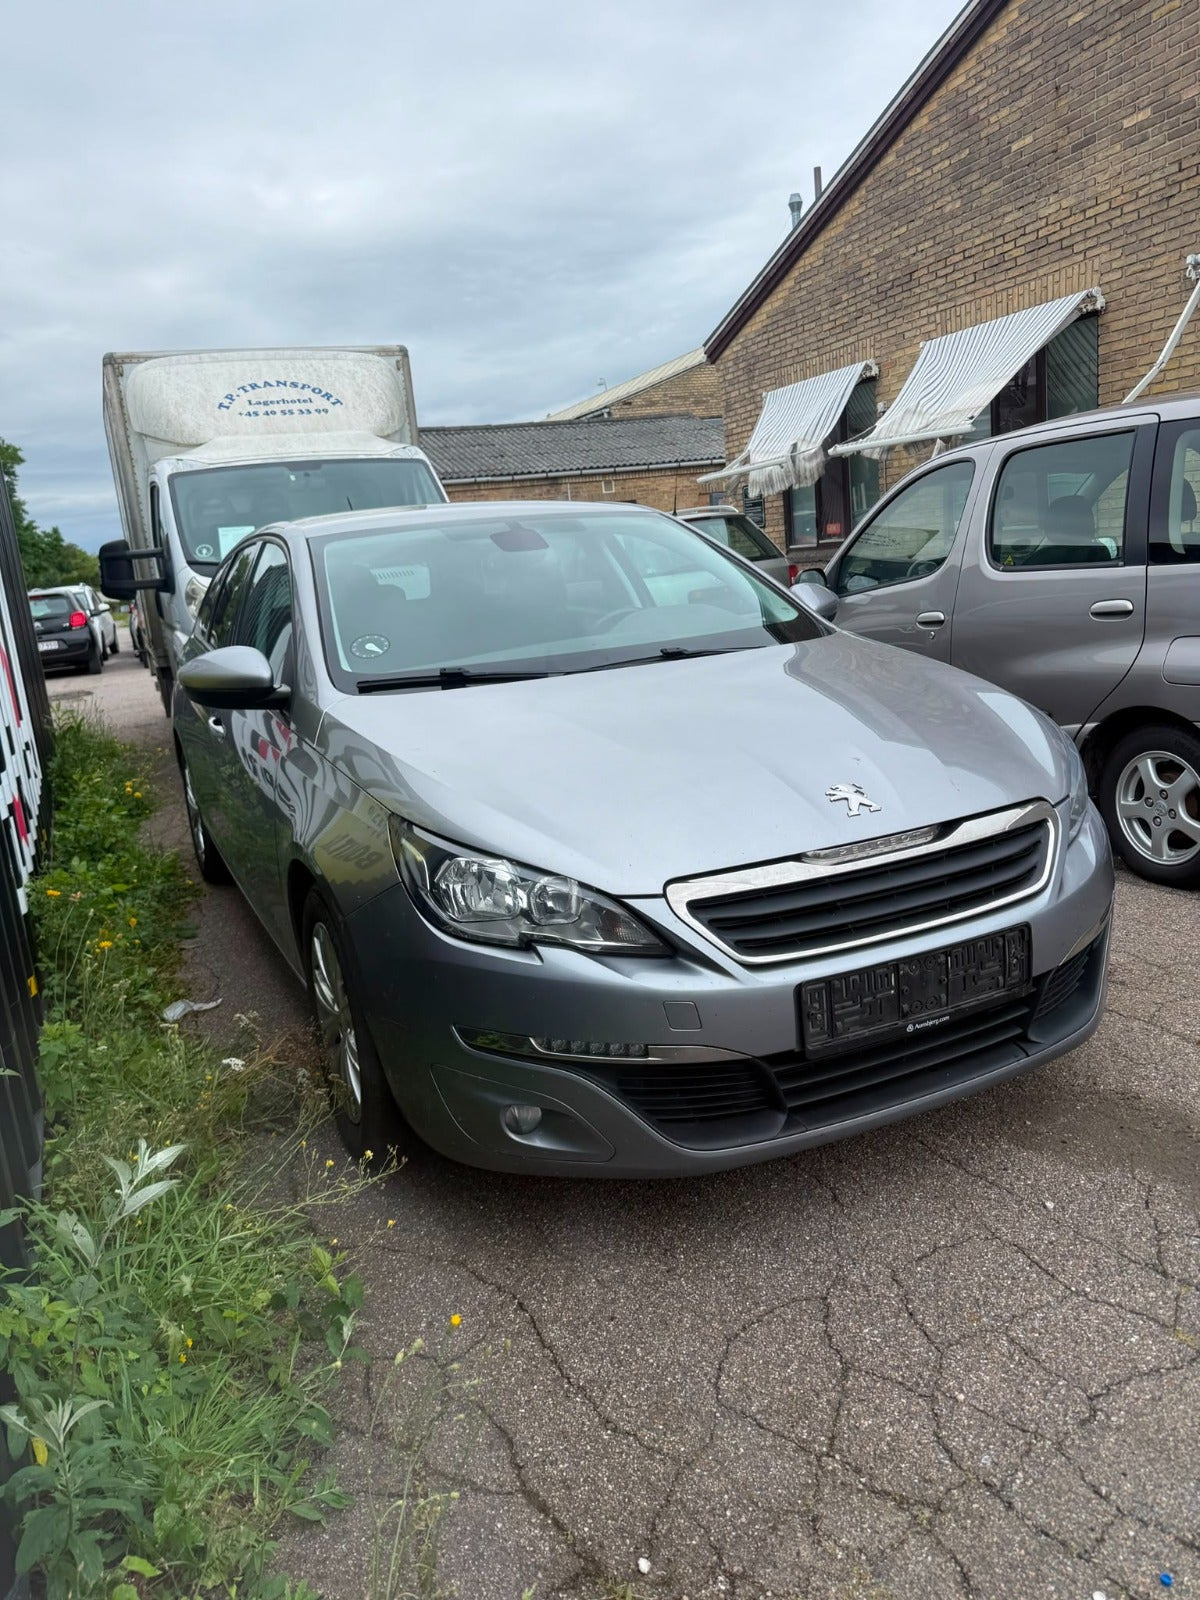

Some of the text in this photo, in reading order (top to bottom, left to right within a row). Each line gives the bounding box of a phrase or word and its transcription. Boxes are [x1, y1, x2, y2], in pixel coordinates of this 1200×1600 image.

[237, 380, 343, 407] TRANSPORT
[247, 397, 313, 406] Lagerhotel
[838, 831, 922, 857] PEUGEOT
